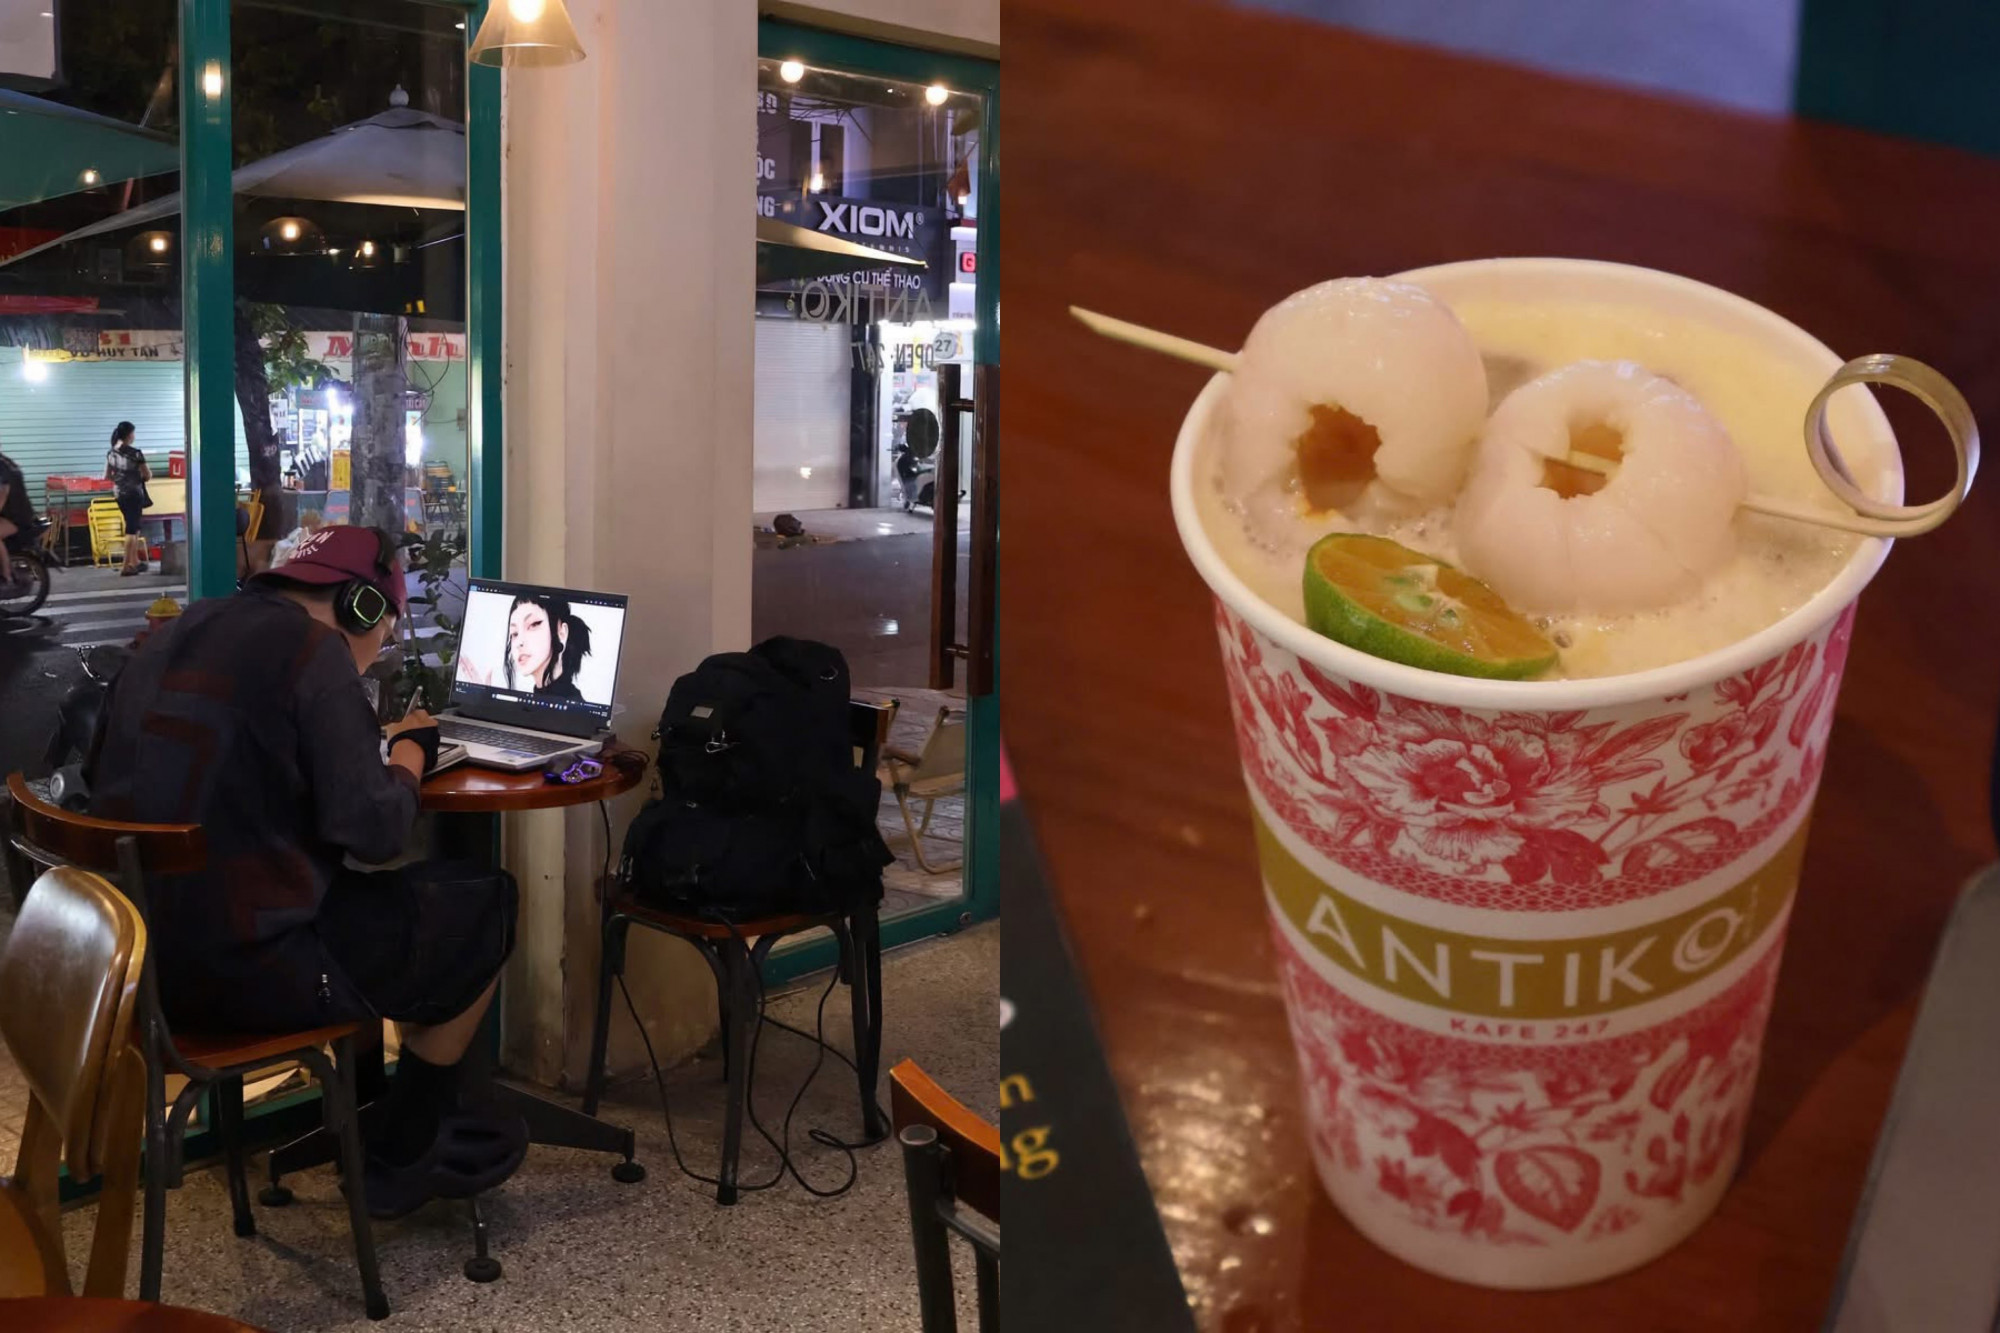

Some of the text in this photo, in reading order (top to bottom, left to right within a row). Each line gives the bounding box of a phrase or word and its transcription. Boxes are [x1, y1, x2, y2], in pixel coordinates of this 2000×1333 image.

[818, 201, 914, 239] XIOM
[893, 273, 921, 289] THAO
[97, 347, 125, 357] HUY
[935, 340, 952, 353] 27
[1306, 894, 1744, 1008] ANTIKO
[1451, 1018, 1611, 1040] KAFE 247
